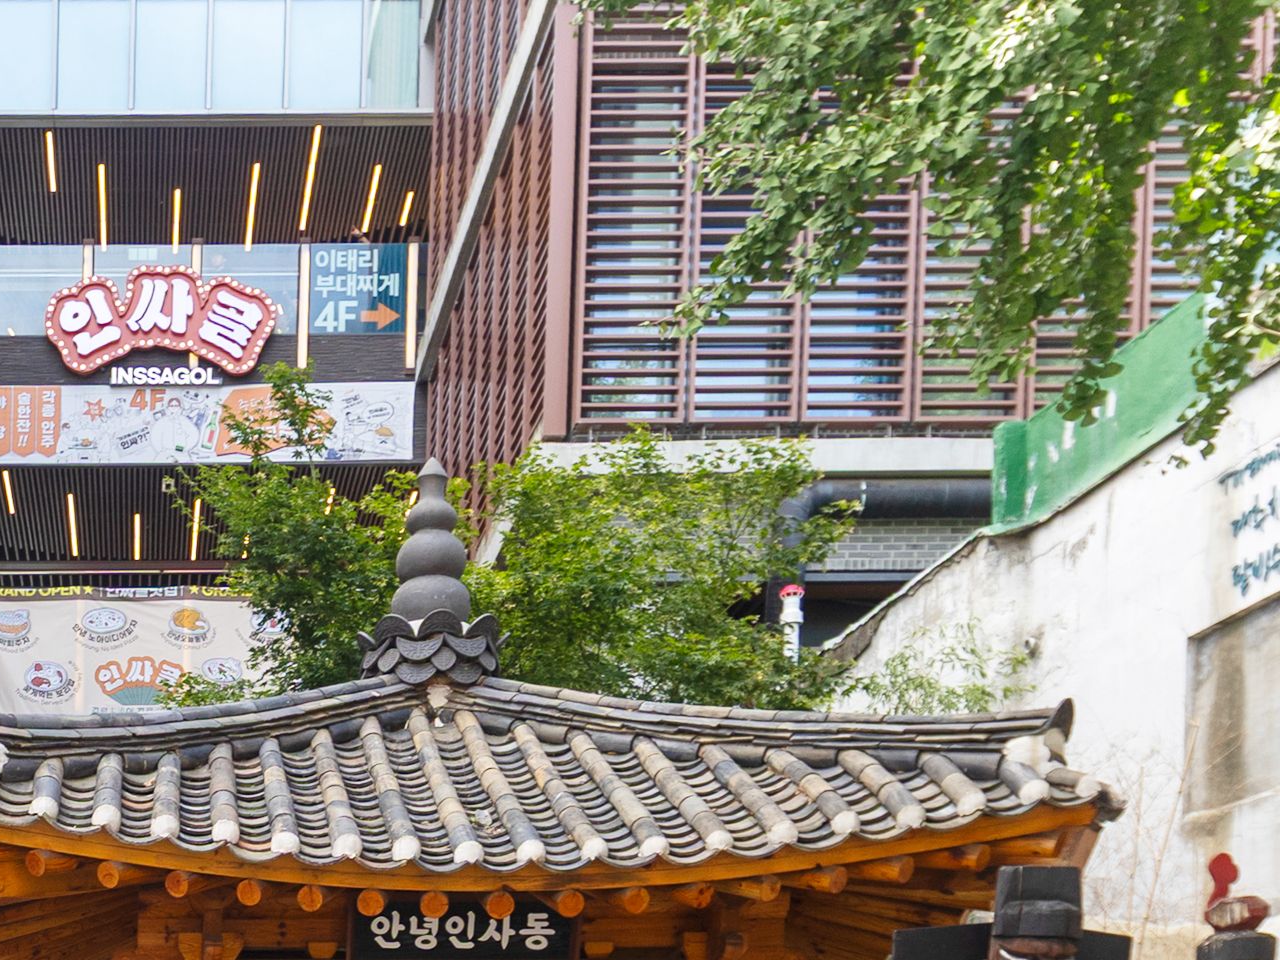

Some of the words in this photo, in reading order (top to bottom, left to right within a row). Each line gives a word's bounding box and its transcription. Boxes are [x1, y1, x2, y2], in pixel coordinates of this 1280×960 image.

[315, 248, 378, 273] 이태리
[59, 278, 263, 359] 인싸골
[314, 300, 359, 332] 4F
[111, 366, 220, 385] INSSAGOL
[130, 388, 166, 412] 4F
[370, 910, 556, 950] 안녕인사동
